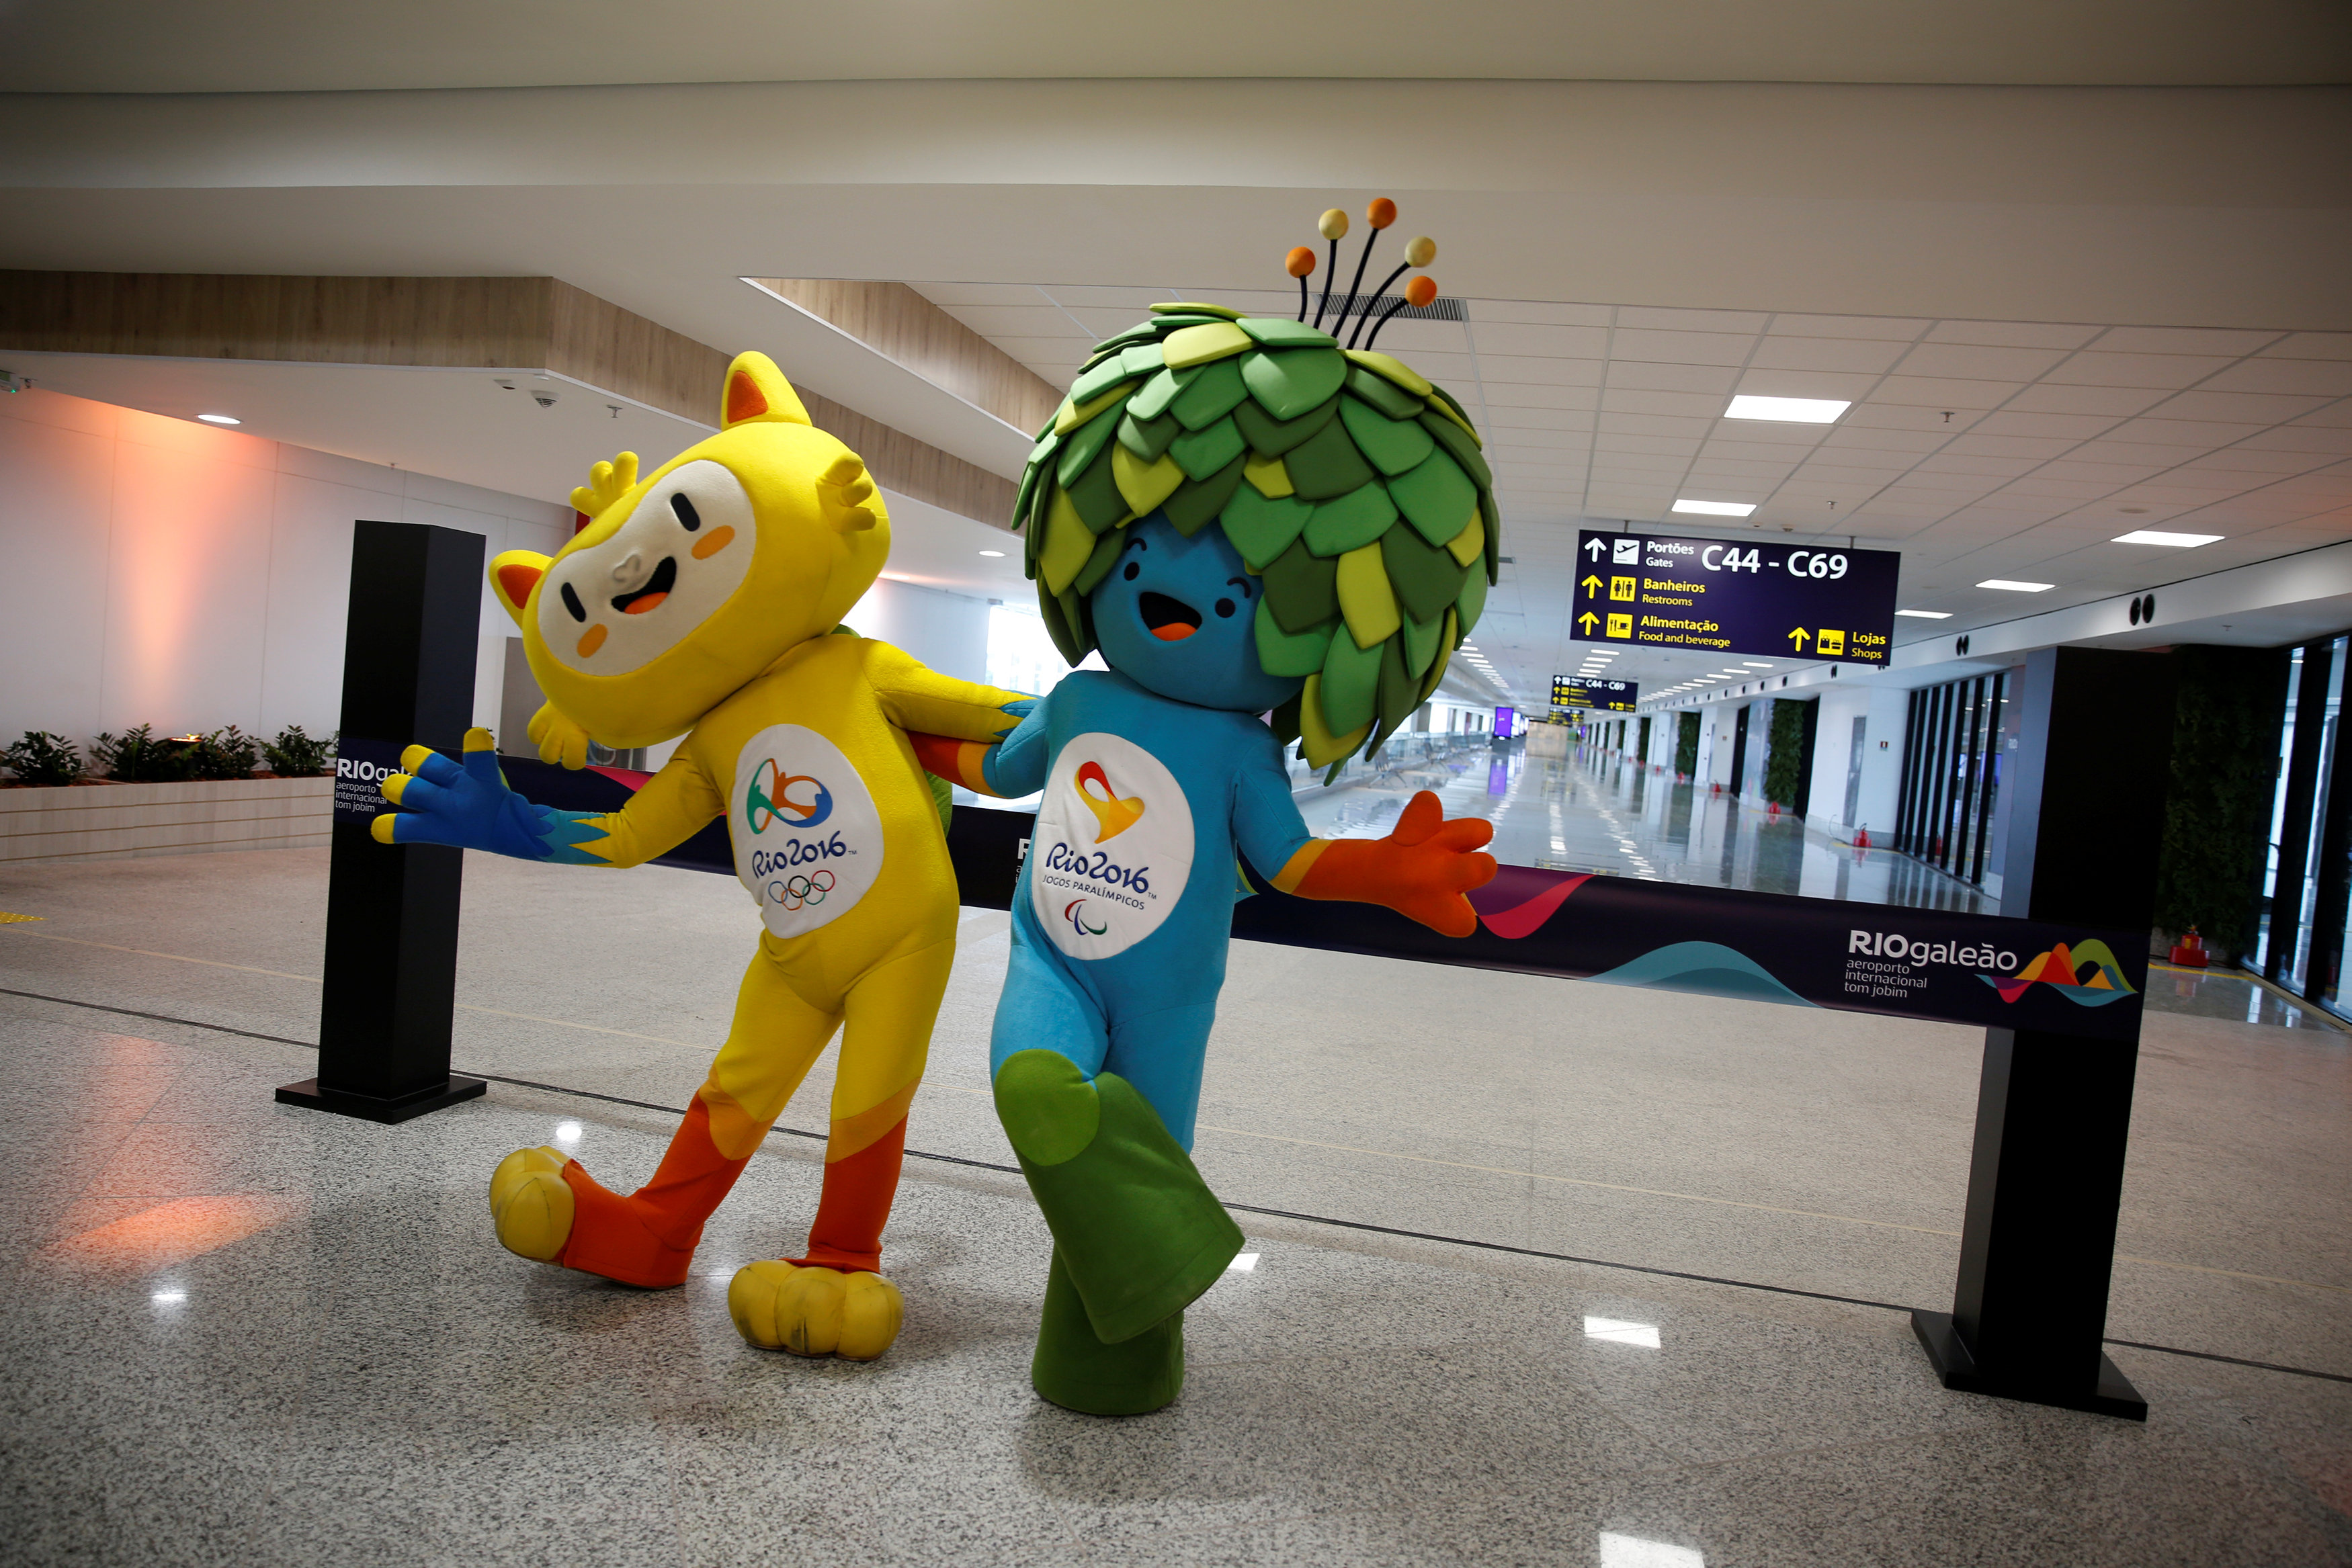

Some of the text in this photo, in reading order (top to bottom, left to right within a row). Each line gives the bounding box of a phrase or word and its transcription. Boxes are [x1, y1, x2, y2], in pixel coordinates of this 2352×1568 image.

[1645, 556, 1674, 568] Gates
[1646, 540, 1695, 555] Portões
[1702, 545, 1761, 574] C44
[1787, 550, 1849, 580] C69
[1643, 578, 1706, 593] Banheiros
[1642, 594, 1693, 607] Restrooms
[1640, 615, 1719, 634] Alimentação
[1638, 631, 1731, 649] Food and beverage
[1853, 631, 1886, 646] Lojas
[1851, 648, 1882, 660] Shops
[1585, 679, 1603, 689] C44
[1608, 681, 1626, 691] C69
[336, 782, 376, 793] aeroporto
[335, 790, 388, 805] internacional
[335, 800, 376, 813] tom jobim
[1042, 874, 1070, 888] JOGOS
[1073, 881, 1145, 910] PARALÍMPICOS
[1849, 929, 2017, 971] RIOgaleão
[1846, 959, 1910, 975] aeroporto
[1845, 969, 1927, 989] internacional
[1844, 982, 1908, 999] tom jobim
